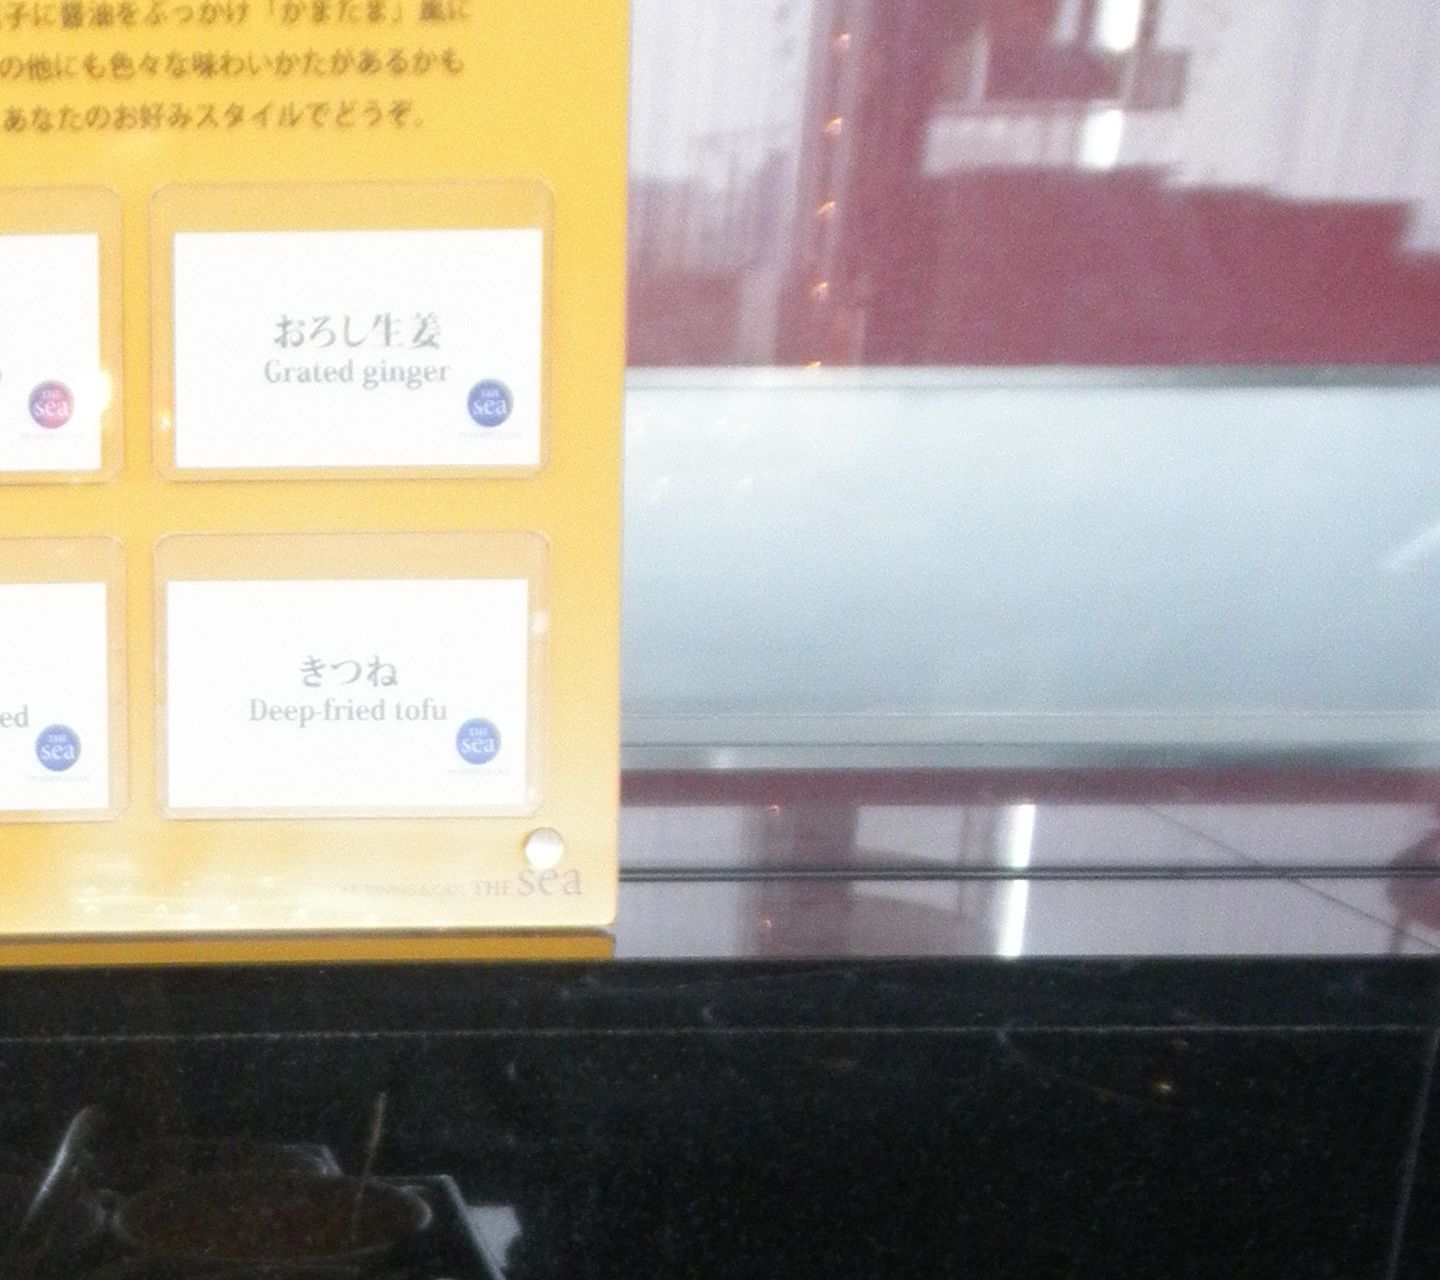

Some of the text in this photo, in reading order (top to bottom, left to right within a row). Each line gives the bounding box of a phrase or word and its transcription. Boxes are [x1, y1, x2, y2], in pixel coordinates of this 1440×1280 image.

[273, 311, 442, 350] おろし生姜
[264, 358, 451, 391] Grated ginger
[34, 401, 70, 418] sea
[473, 400, 508, 417] sea
[300, 654, 399, 688] きつね
[395, 697, 448, 722] tofu
[40, 743, 76, 760] sea
[461, 738, 496, 755] sea
[517, 868, 583, 897] sea
